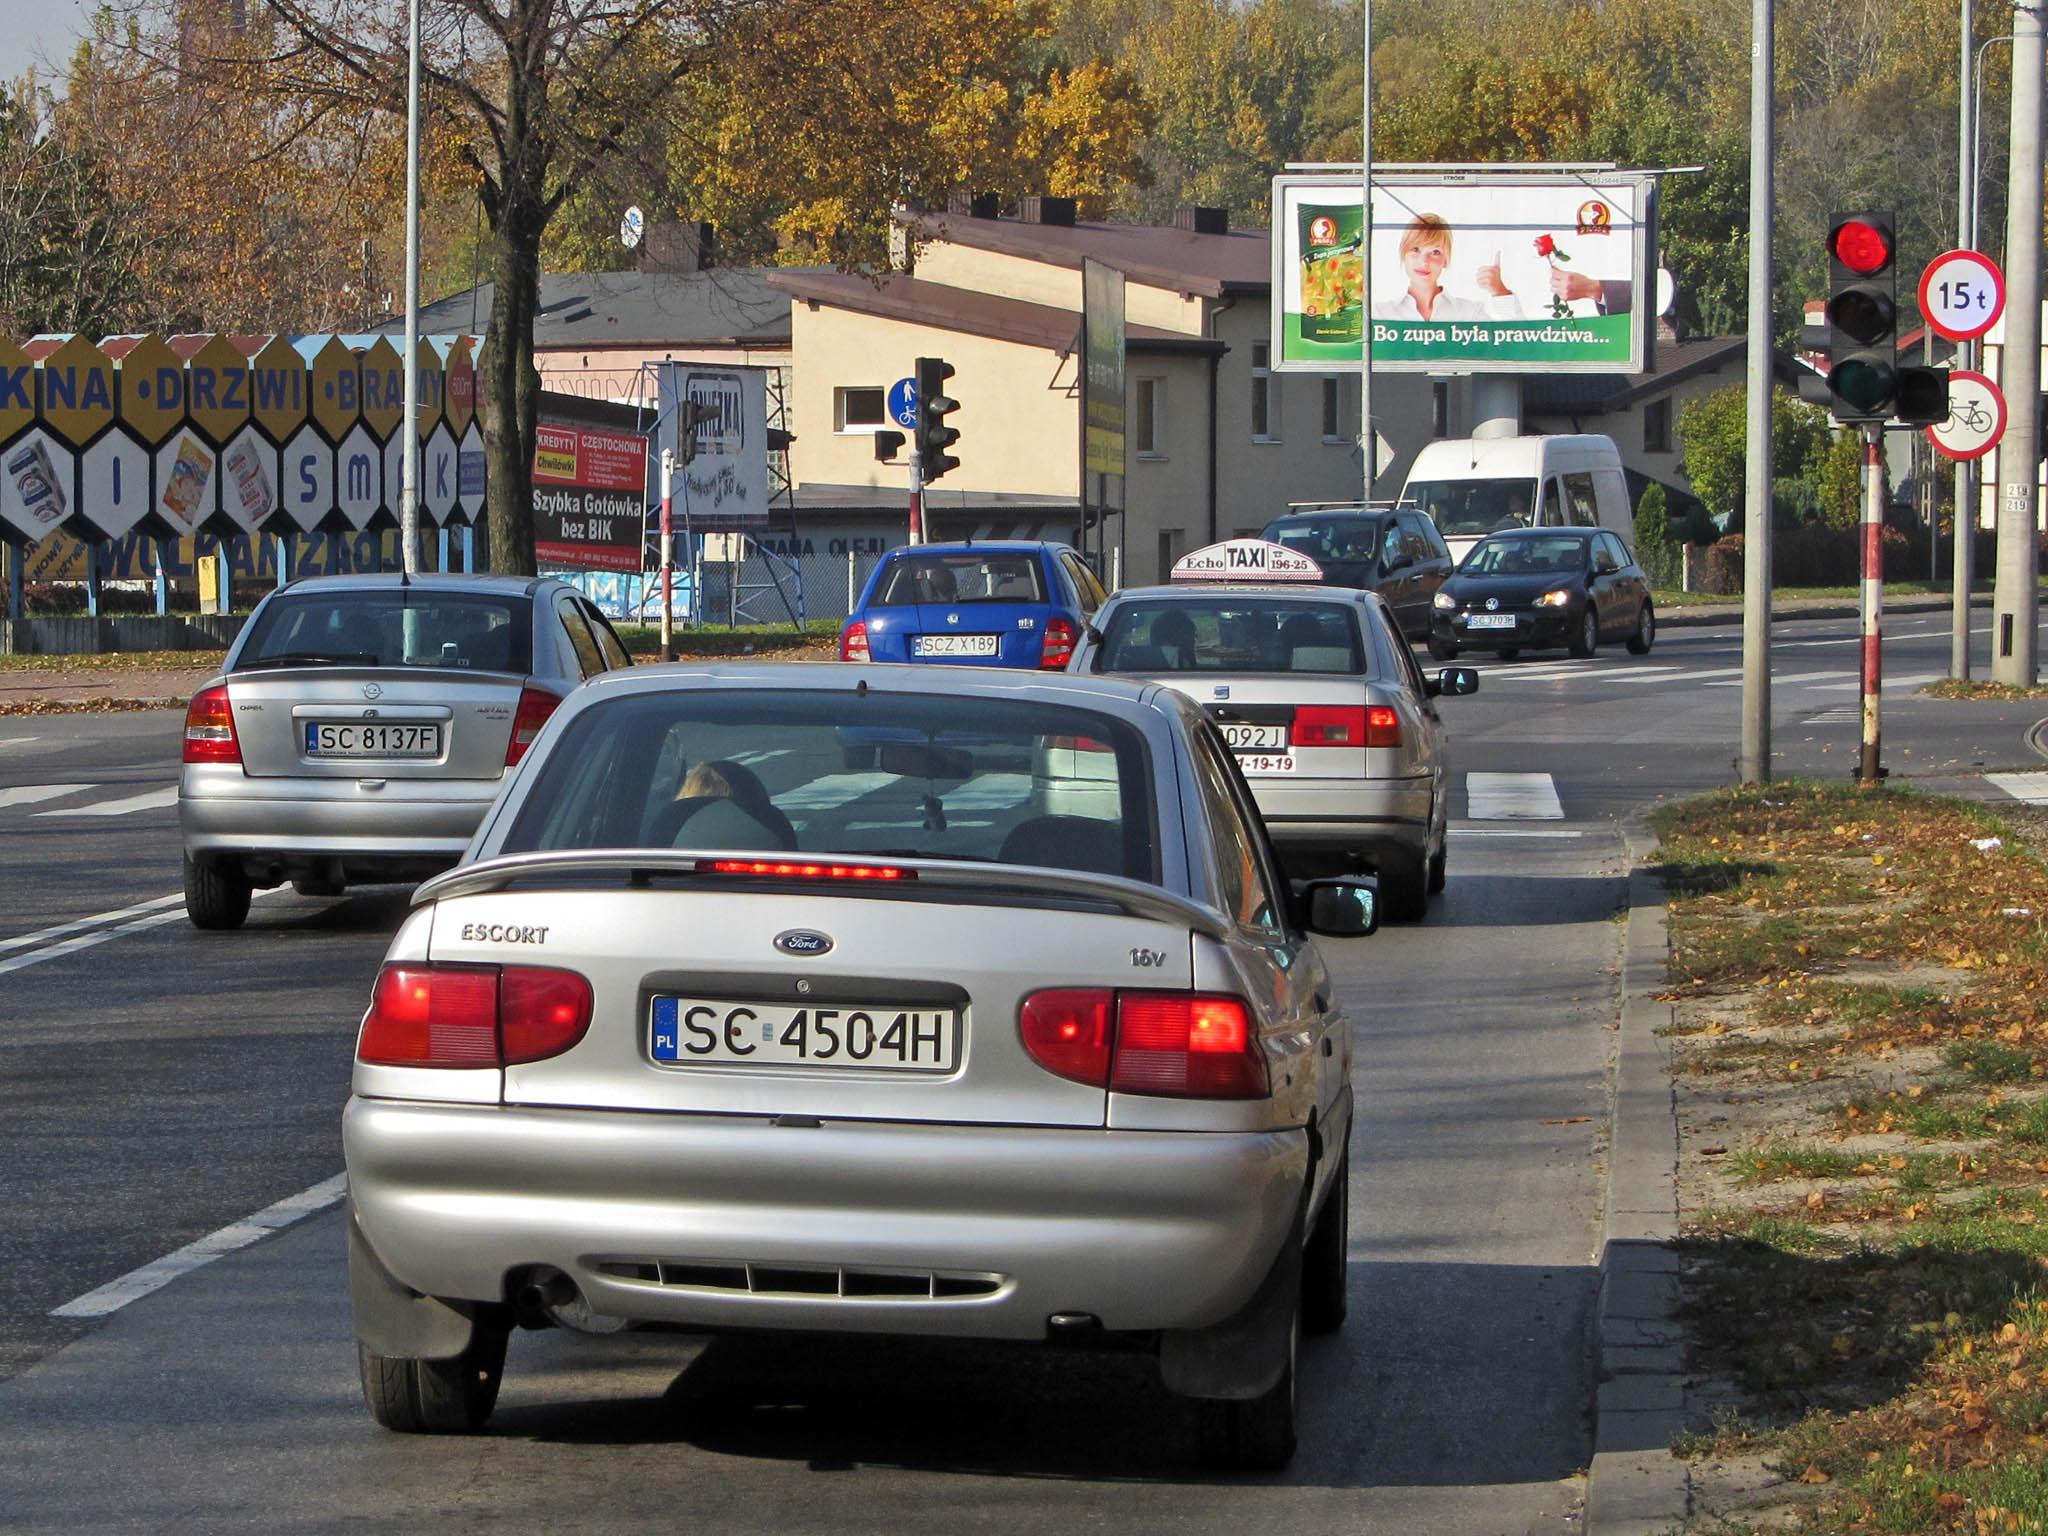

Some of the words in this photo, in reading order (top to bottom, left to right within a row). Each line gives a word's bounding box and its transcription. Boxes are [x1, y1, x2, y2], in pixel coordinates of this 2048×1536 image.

[1939, 282, 1970, 310] 15
[1976, 290, 1986, 310] t
[1374, 325, 1398, 341] Bo
[1403, 329, 1446, 345] zupa
[1451, 325, 1489, 345] była
[1494, 327, 1610, 344] prawdziwa...
[538, 435, 574, 450] KREDYTY
[582, 435, 642, 455] CZĘSTOCHOWA
[533, 489, 580, 517] Szybka
[584, 493, 642, 517] Gotówka
[2007, 501, 2026, 510] 219
[561, 517, 584, 539] bez
[588, 519, 612, 540] BIK
[1187, 557, 1224, 569] Echo
[1227, 548, 1265, 567] TAXI
[1271, 560, 1308, 569] 196-25
[924, 638, 955, 652] SCZ
[961, 637, 995, 651] X189
[321, 728, 353, 749] SC
[363, 728, 434, 750] 8137F
[1226, 727, 1279, 747] 092J
[462, 923, 549, 944] ESCORT
[789, 935, 818, 949] Ford
[656, 1035, 674, 1048] PL
[684, 1006, 758, 1056] SC
[779, 1009, 942, 1062] 4504H
